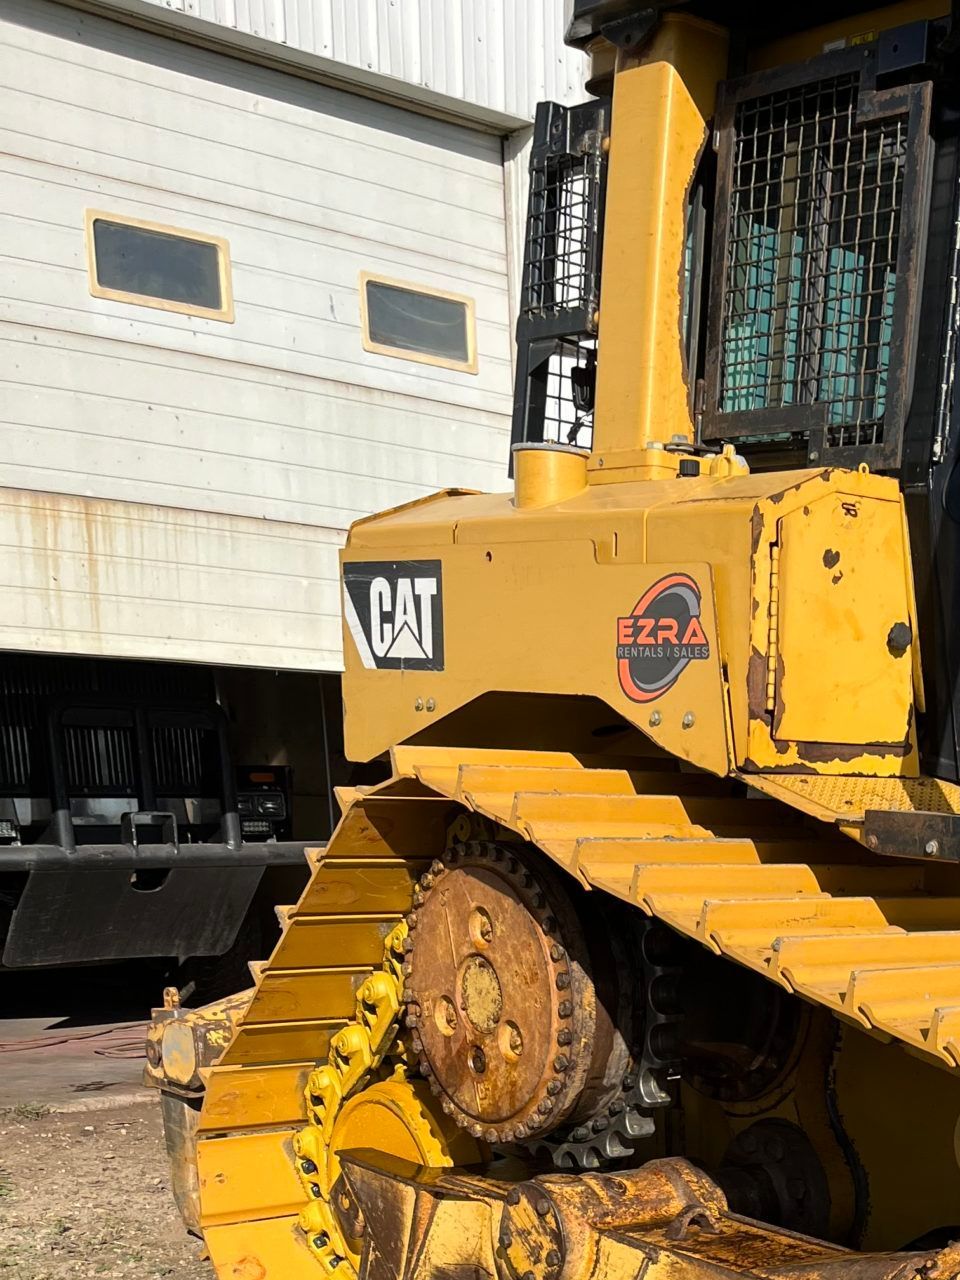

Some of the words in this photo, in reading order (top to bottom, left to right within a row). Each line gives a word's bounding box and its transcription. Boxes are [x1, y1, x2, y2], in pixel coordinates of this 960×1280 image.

[370, 577, 437, 659] CAT
[618, 617, 707, 644] EZRA
[618, 647, 663, 657] RENTALS
[674, 647, 708, 657] SALES
